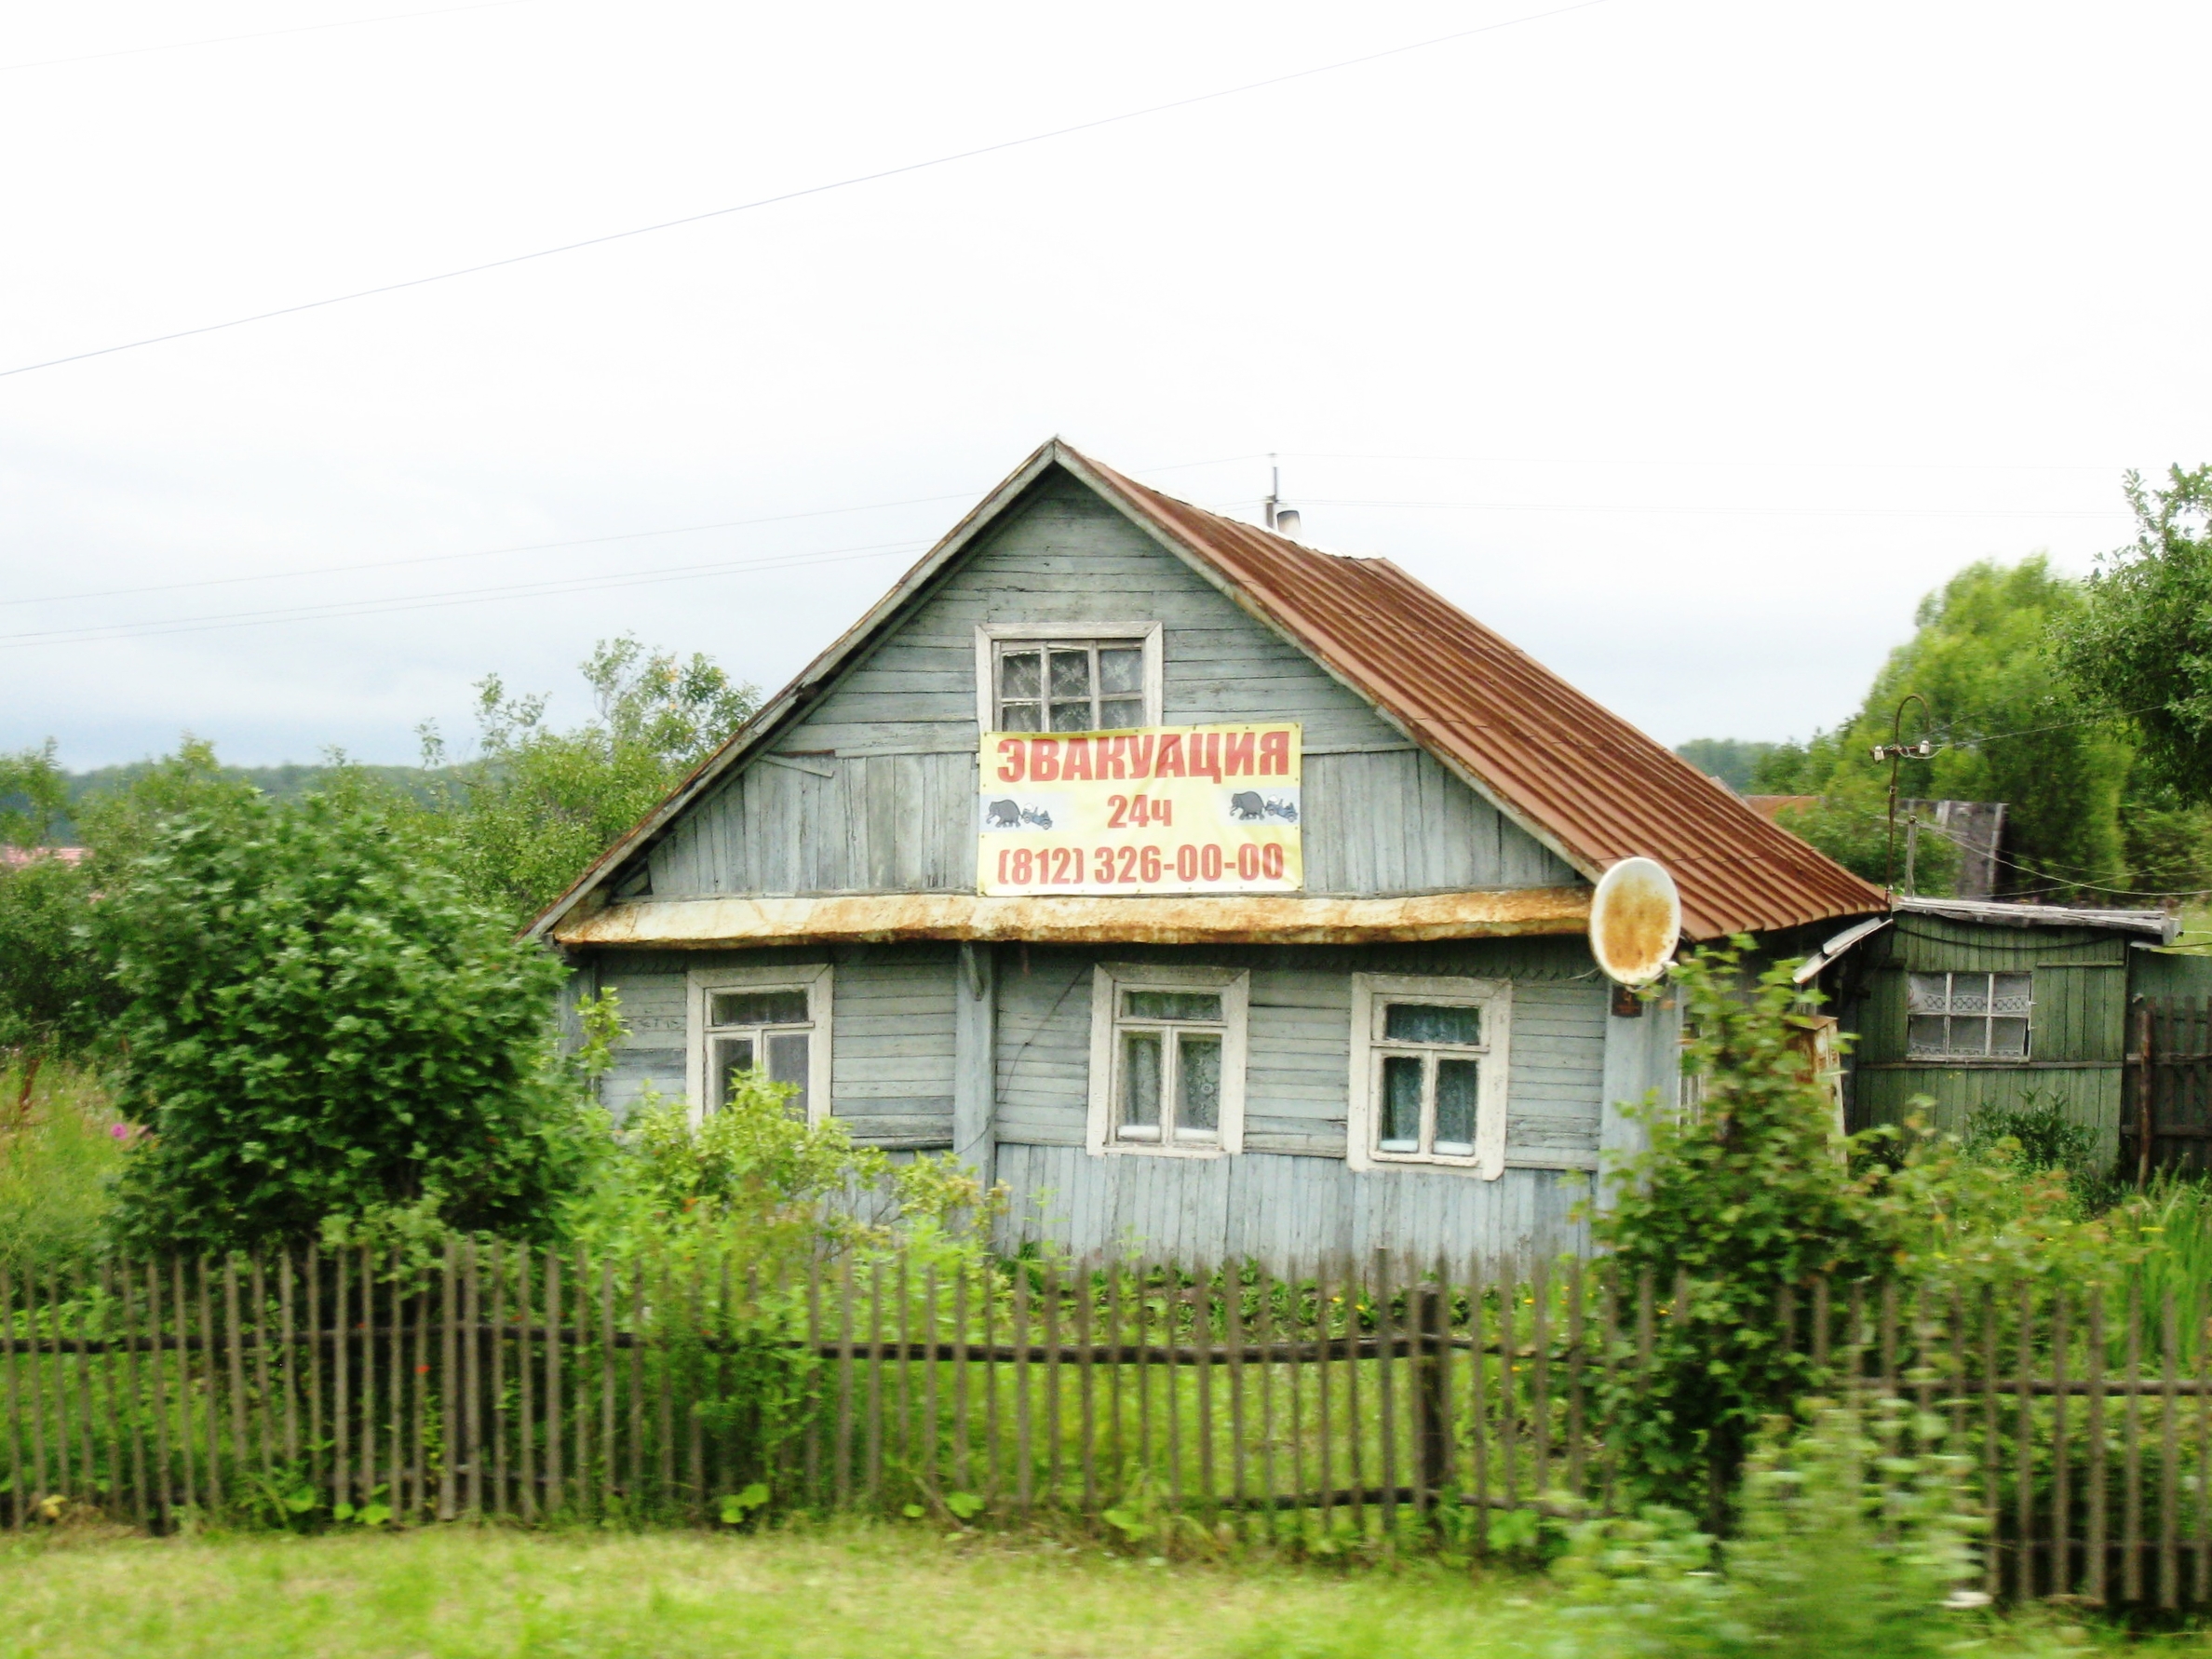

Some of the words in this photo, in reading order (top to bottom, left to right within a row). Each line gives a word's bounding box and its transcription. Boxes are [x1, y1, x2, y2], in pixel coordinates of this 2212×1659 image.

[997, 731, 1290, 784] ЭВАКУАЦИЯ
[1107, 795, 1172, 829] 24ч
[998, 847, 1084, 884] (812)
[1094, 843, 1284, 883] 326-00-00
